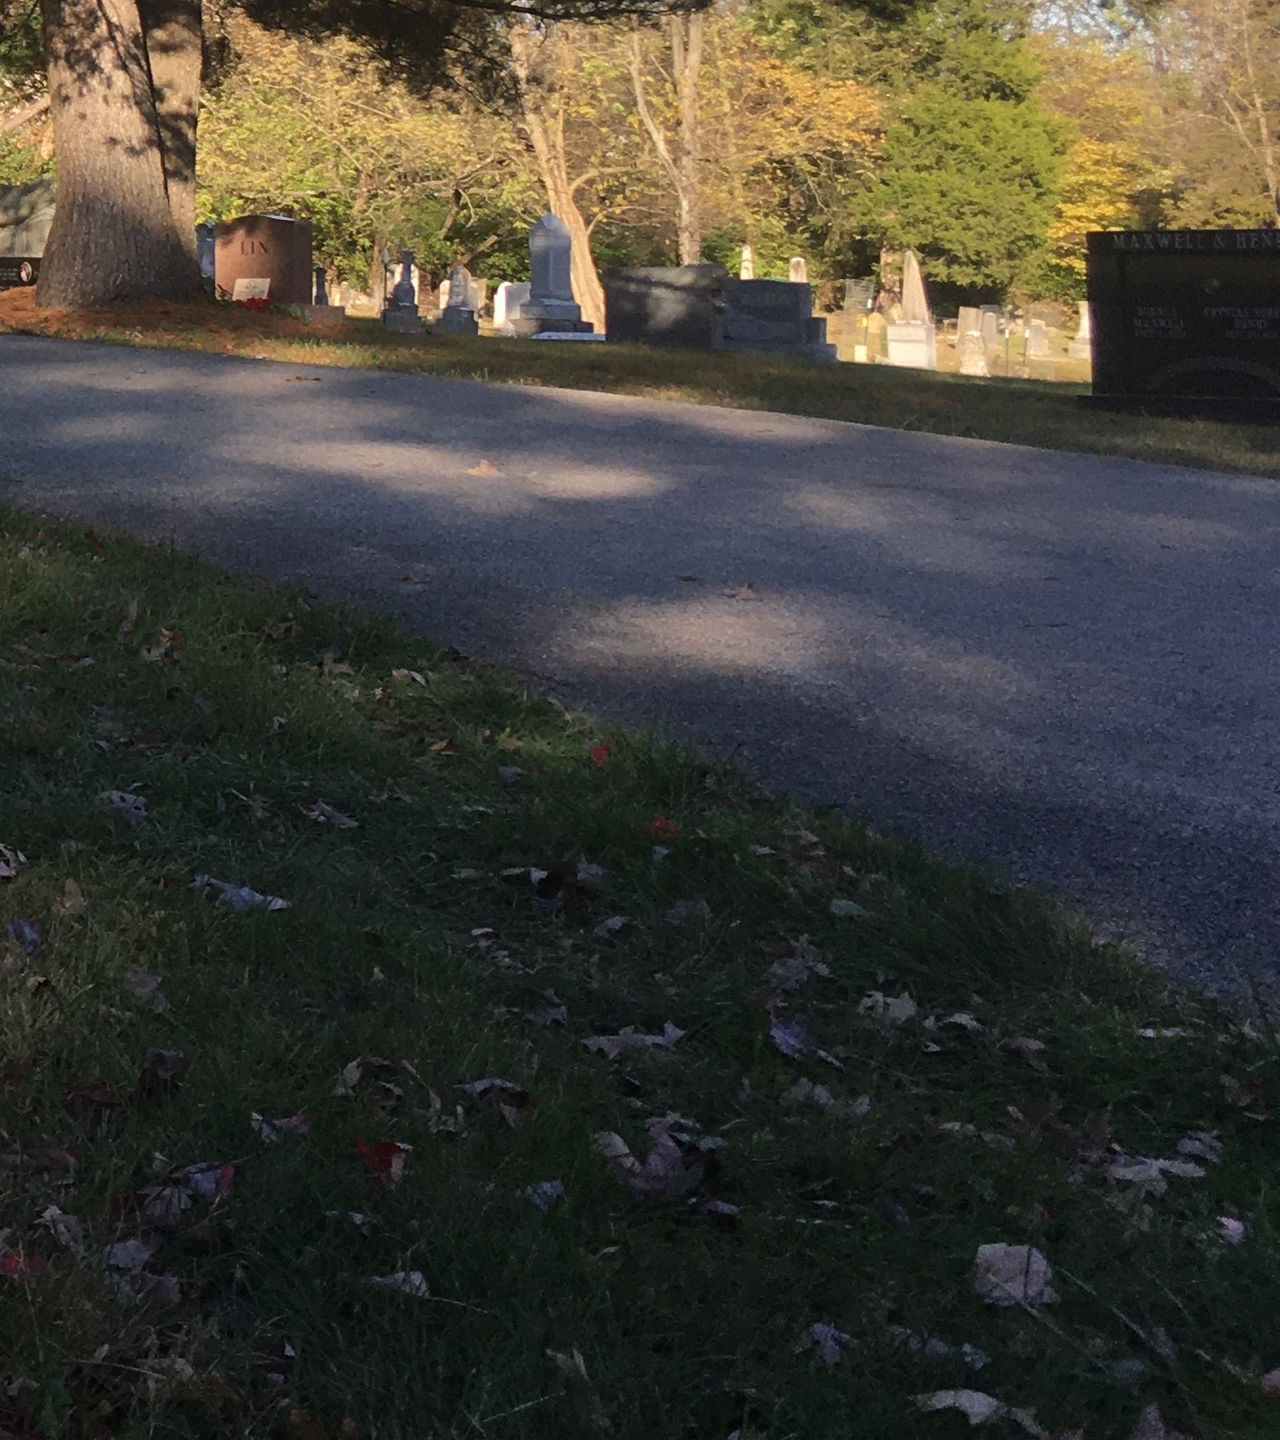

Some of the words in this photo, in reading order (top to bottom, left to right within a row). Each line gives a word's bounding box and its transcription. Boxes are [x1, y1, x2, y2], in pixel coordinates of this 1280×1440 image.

[240, 241, 268, 255] LIN
[1112, 233, 1206, 249] MAXWELL
[1213, 233, 1225, 249] &
